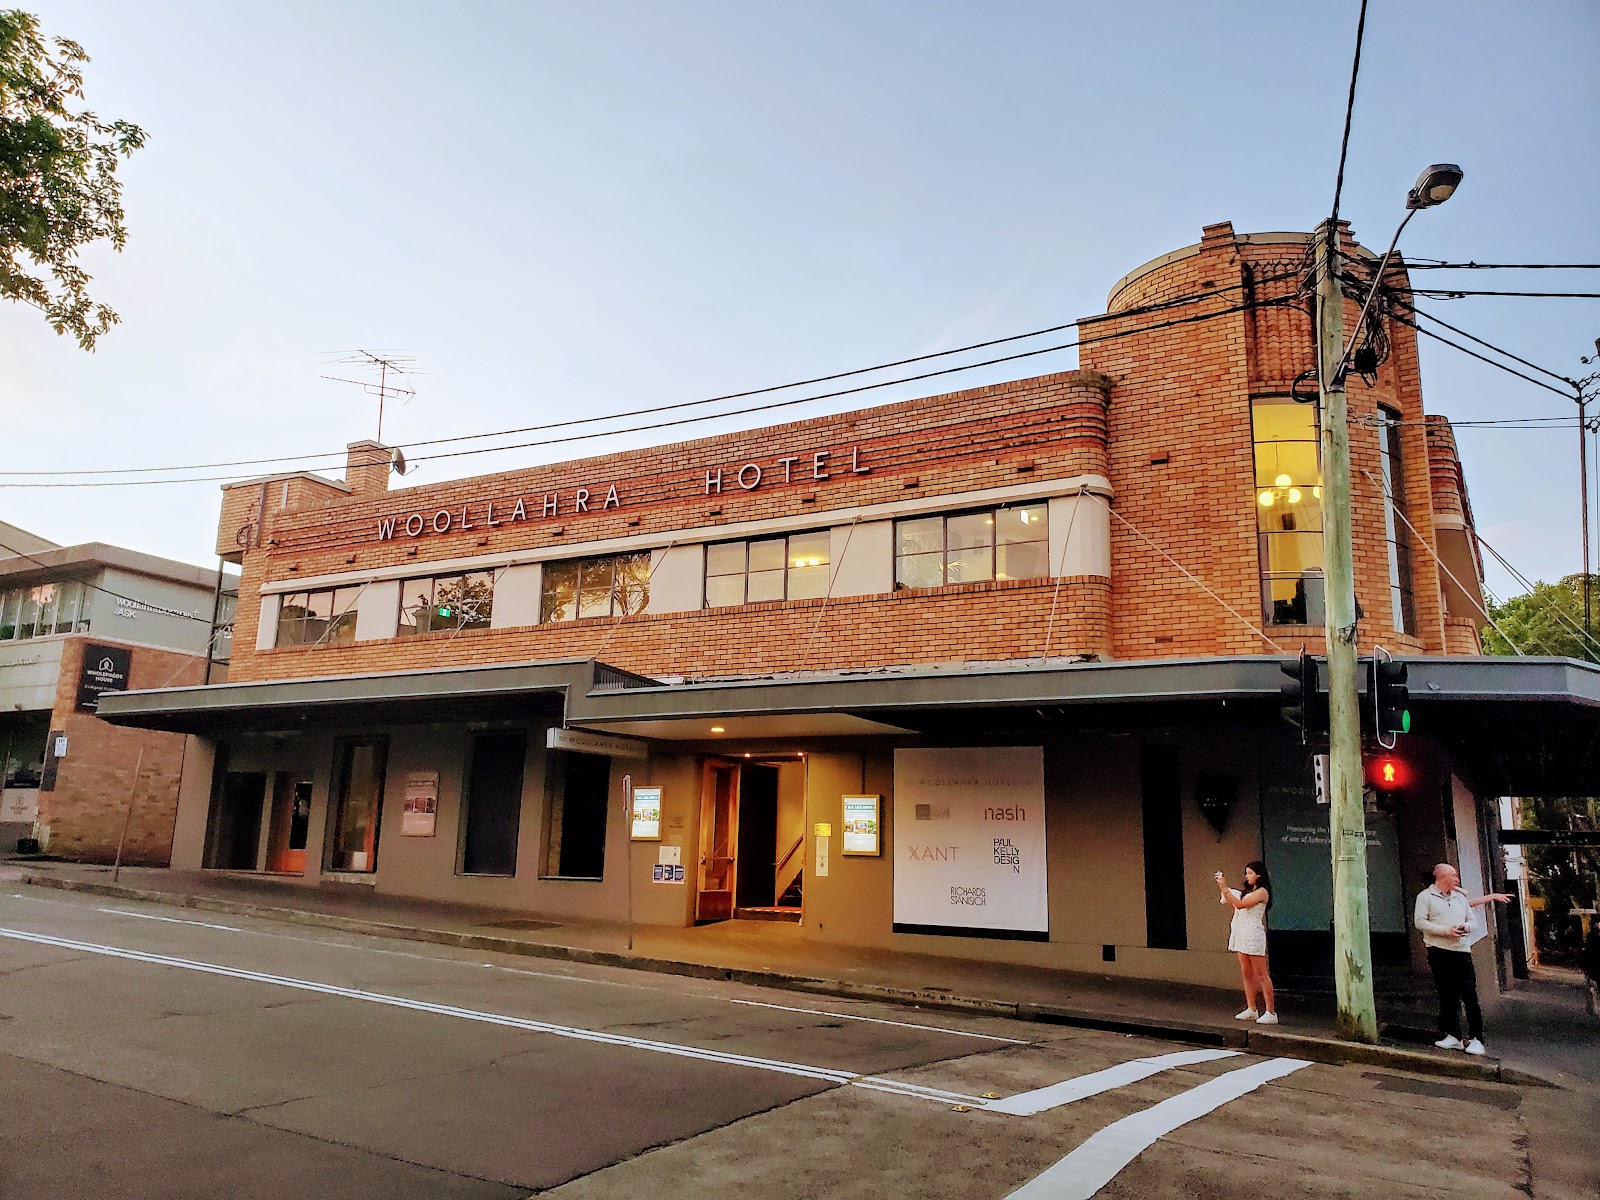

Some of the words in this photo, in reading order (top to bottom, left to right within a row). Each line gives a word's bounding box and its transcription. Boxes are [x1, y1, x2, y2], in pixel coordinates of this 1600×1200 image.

[377, 483, 621, 542] WOOLLAHRA
[705, 445, 871, 496] HOTEL
[984, 804, 1026, 821] nash
[993, 837, 1014, 847] PAUL
[908, 845, 960, 862] XANT
[993, 846, 1020, 856] KELLY
[950, 886, 986, 896] RICHARDS
[950, 896, 986, 906] STANISICH
